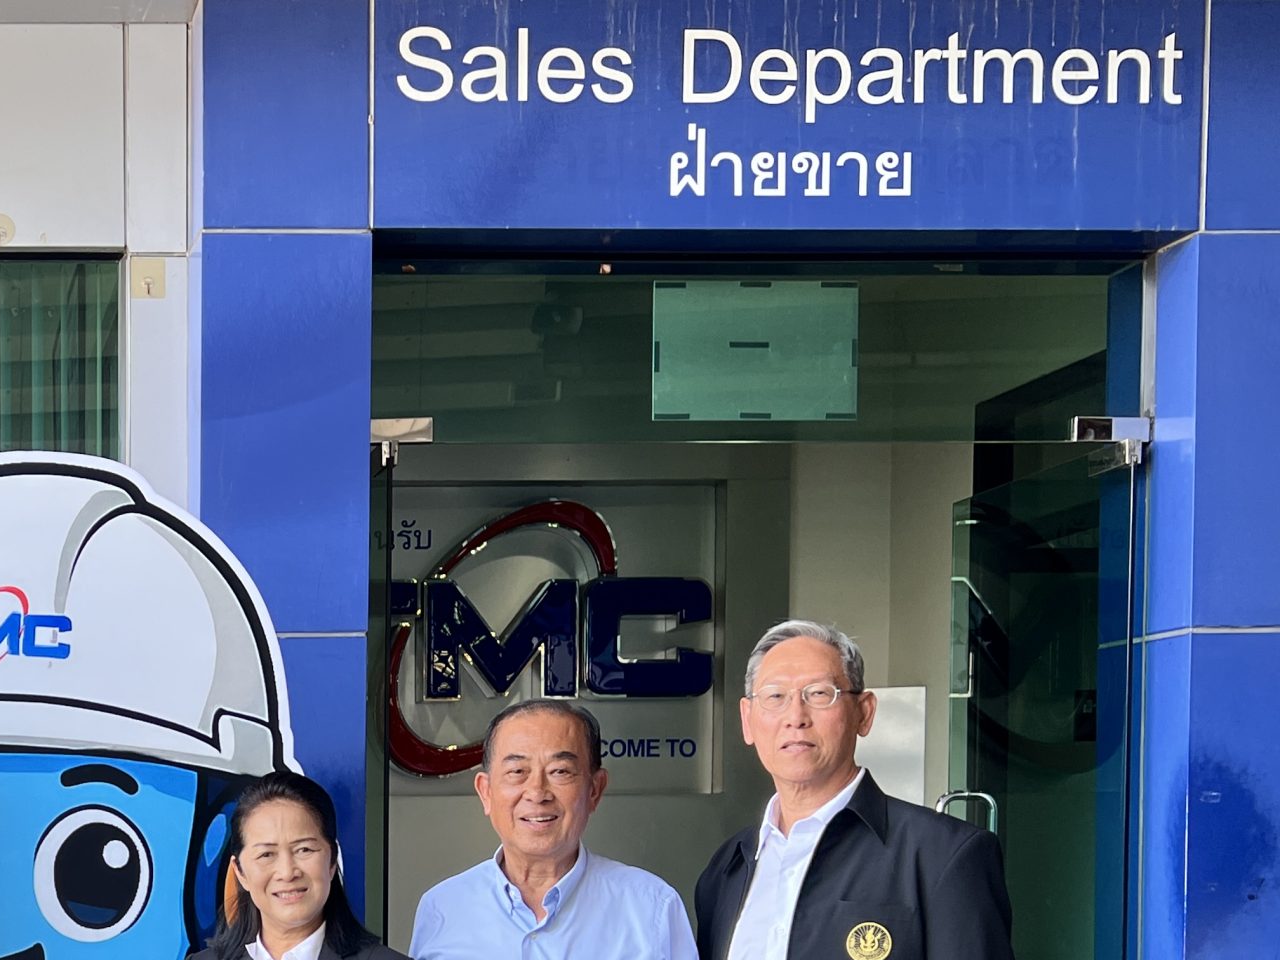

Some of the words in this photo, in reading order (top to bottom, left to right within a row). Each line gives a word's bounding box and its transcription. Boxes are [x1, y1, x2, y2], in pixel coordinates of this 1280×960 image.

[396, 26, 634, 103] Sales
[681, 28, 1183, 124] Department
[669, 122, 913, 197] ฝ่ายขาย
[390, 576, 713, 700] MC
[665, 738, 697, 758] TO
